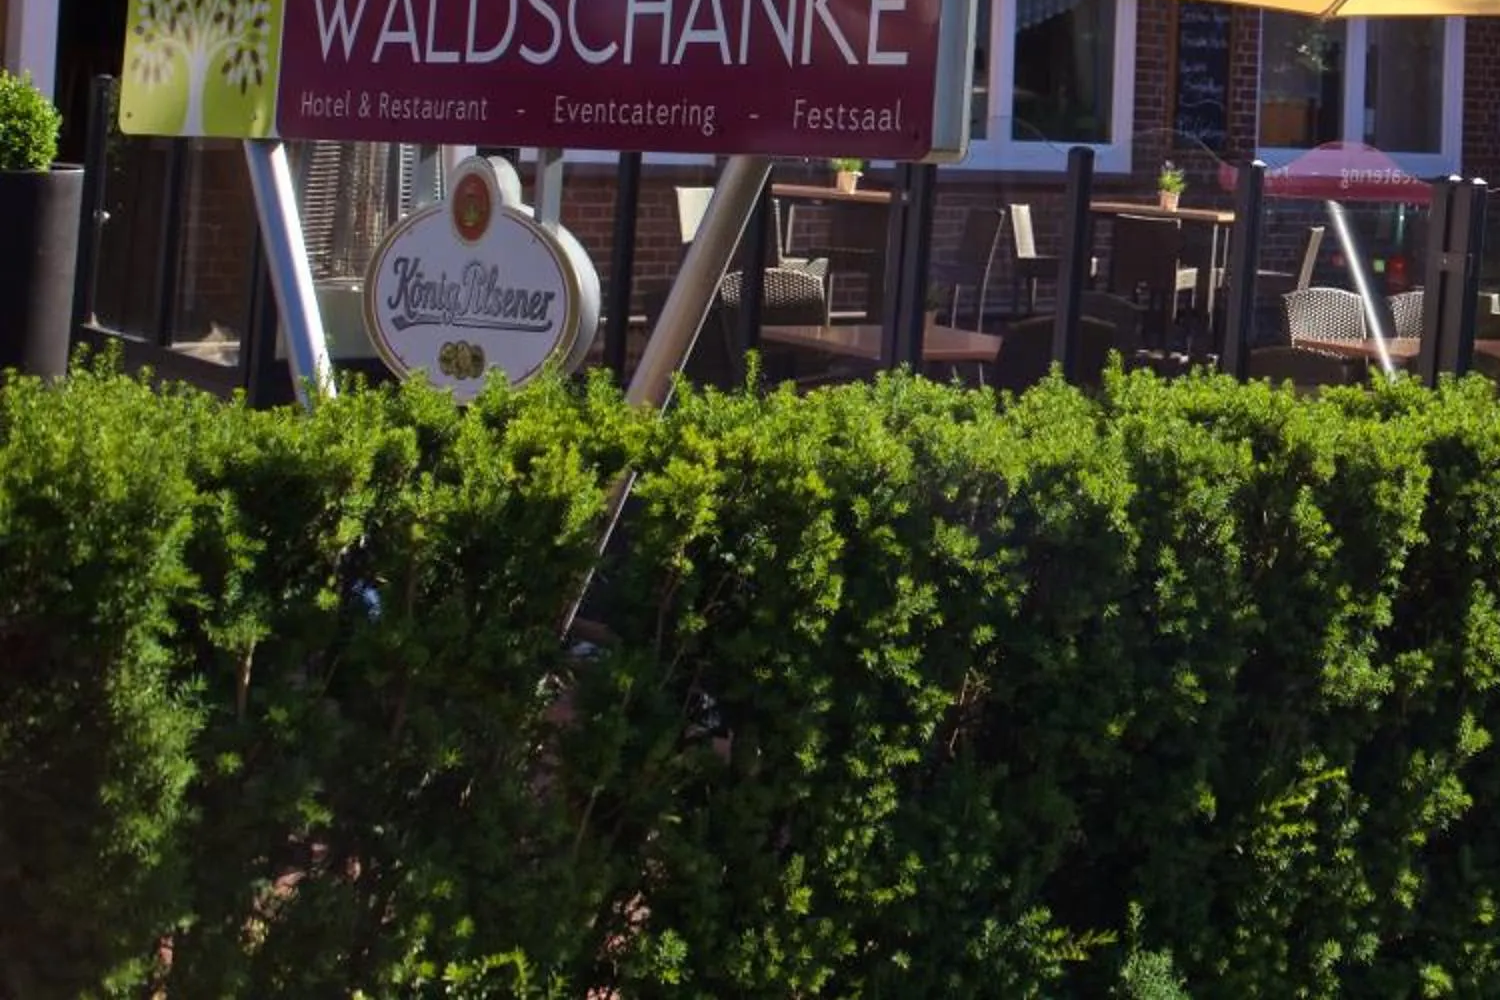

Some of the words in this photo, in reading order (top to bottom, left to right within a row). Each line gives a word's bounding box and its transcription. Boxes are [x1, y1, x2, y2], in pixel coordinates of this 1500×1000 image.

[301, 90, 350, 118] Hotel
[357, 92, 371, 119] &
[378, 91, 488, 122] Restaurant
[553, 95, 717, 137] Eventcatering
[793, 98, 902, 132] Festsaal
[387, 256, 463, 325] König
[461, 259, 556, 322] Pilsener
